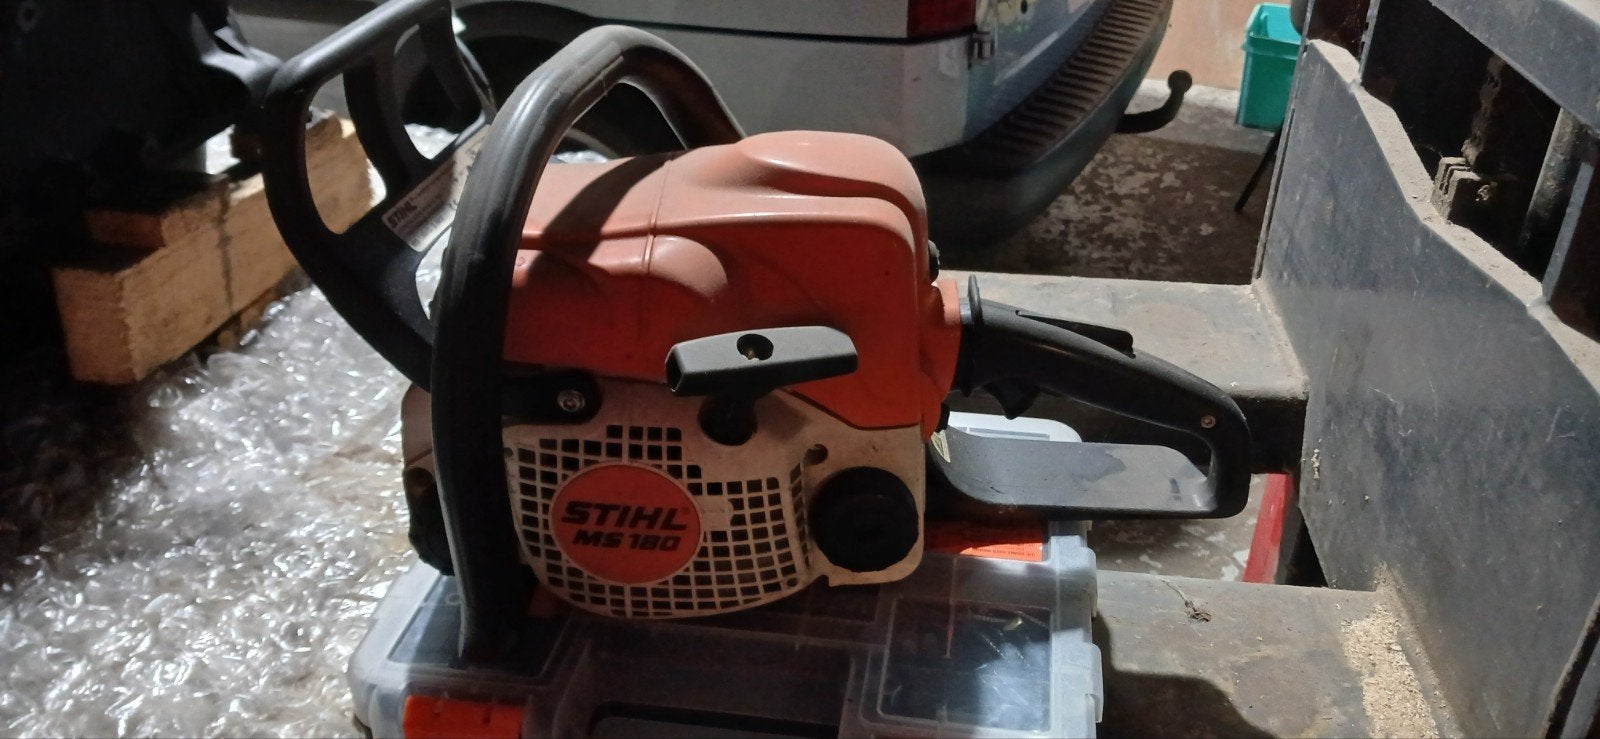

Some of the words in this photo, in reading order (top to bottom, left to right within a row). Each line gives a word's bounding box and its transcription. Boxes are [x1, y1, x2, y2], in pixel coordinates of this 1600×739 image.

[387, 201, 418, 228] STIHL
[561, 501, 687, 531] STIHL
[572, 529, 624, 549] MS
[628, 533, 682, 550] 180
